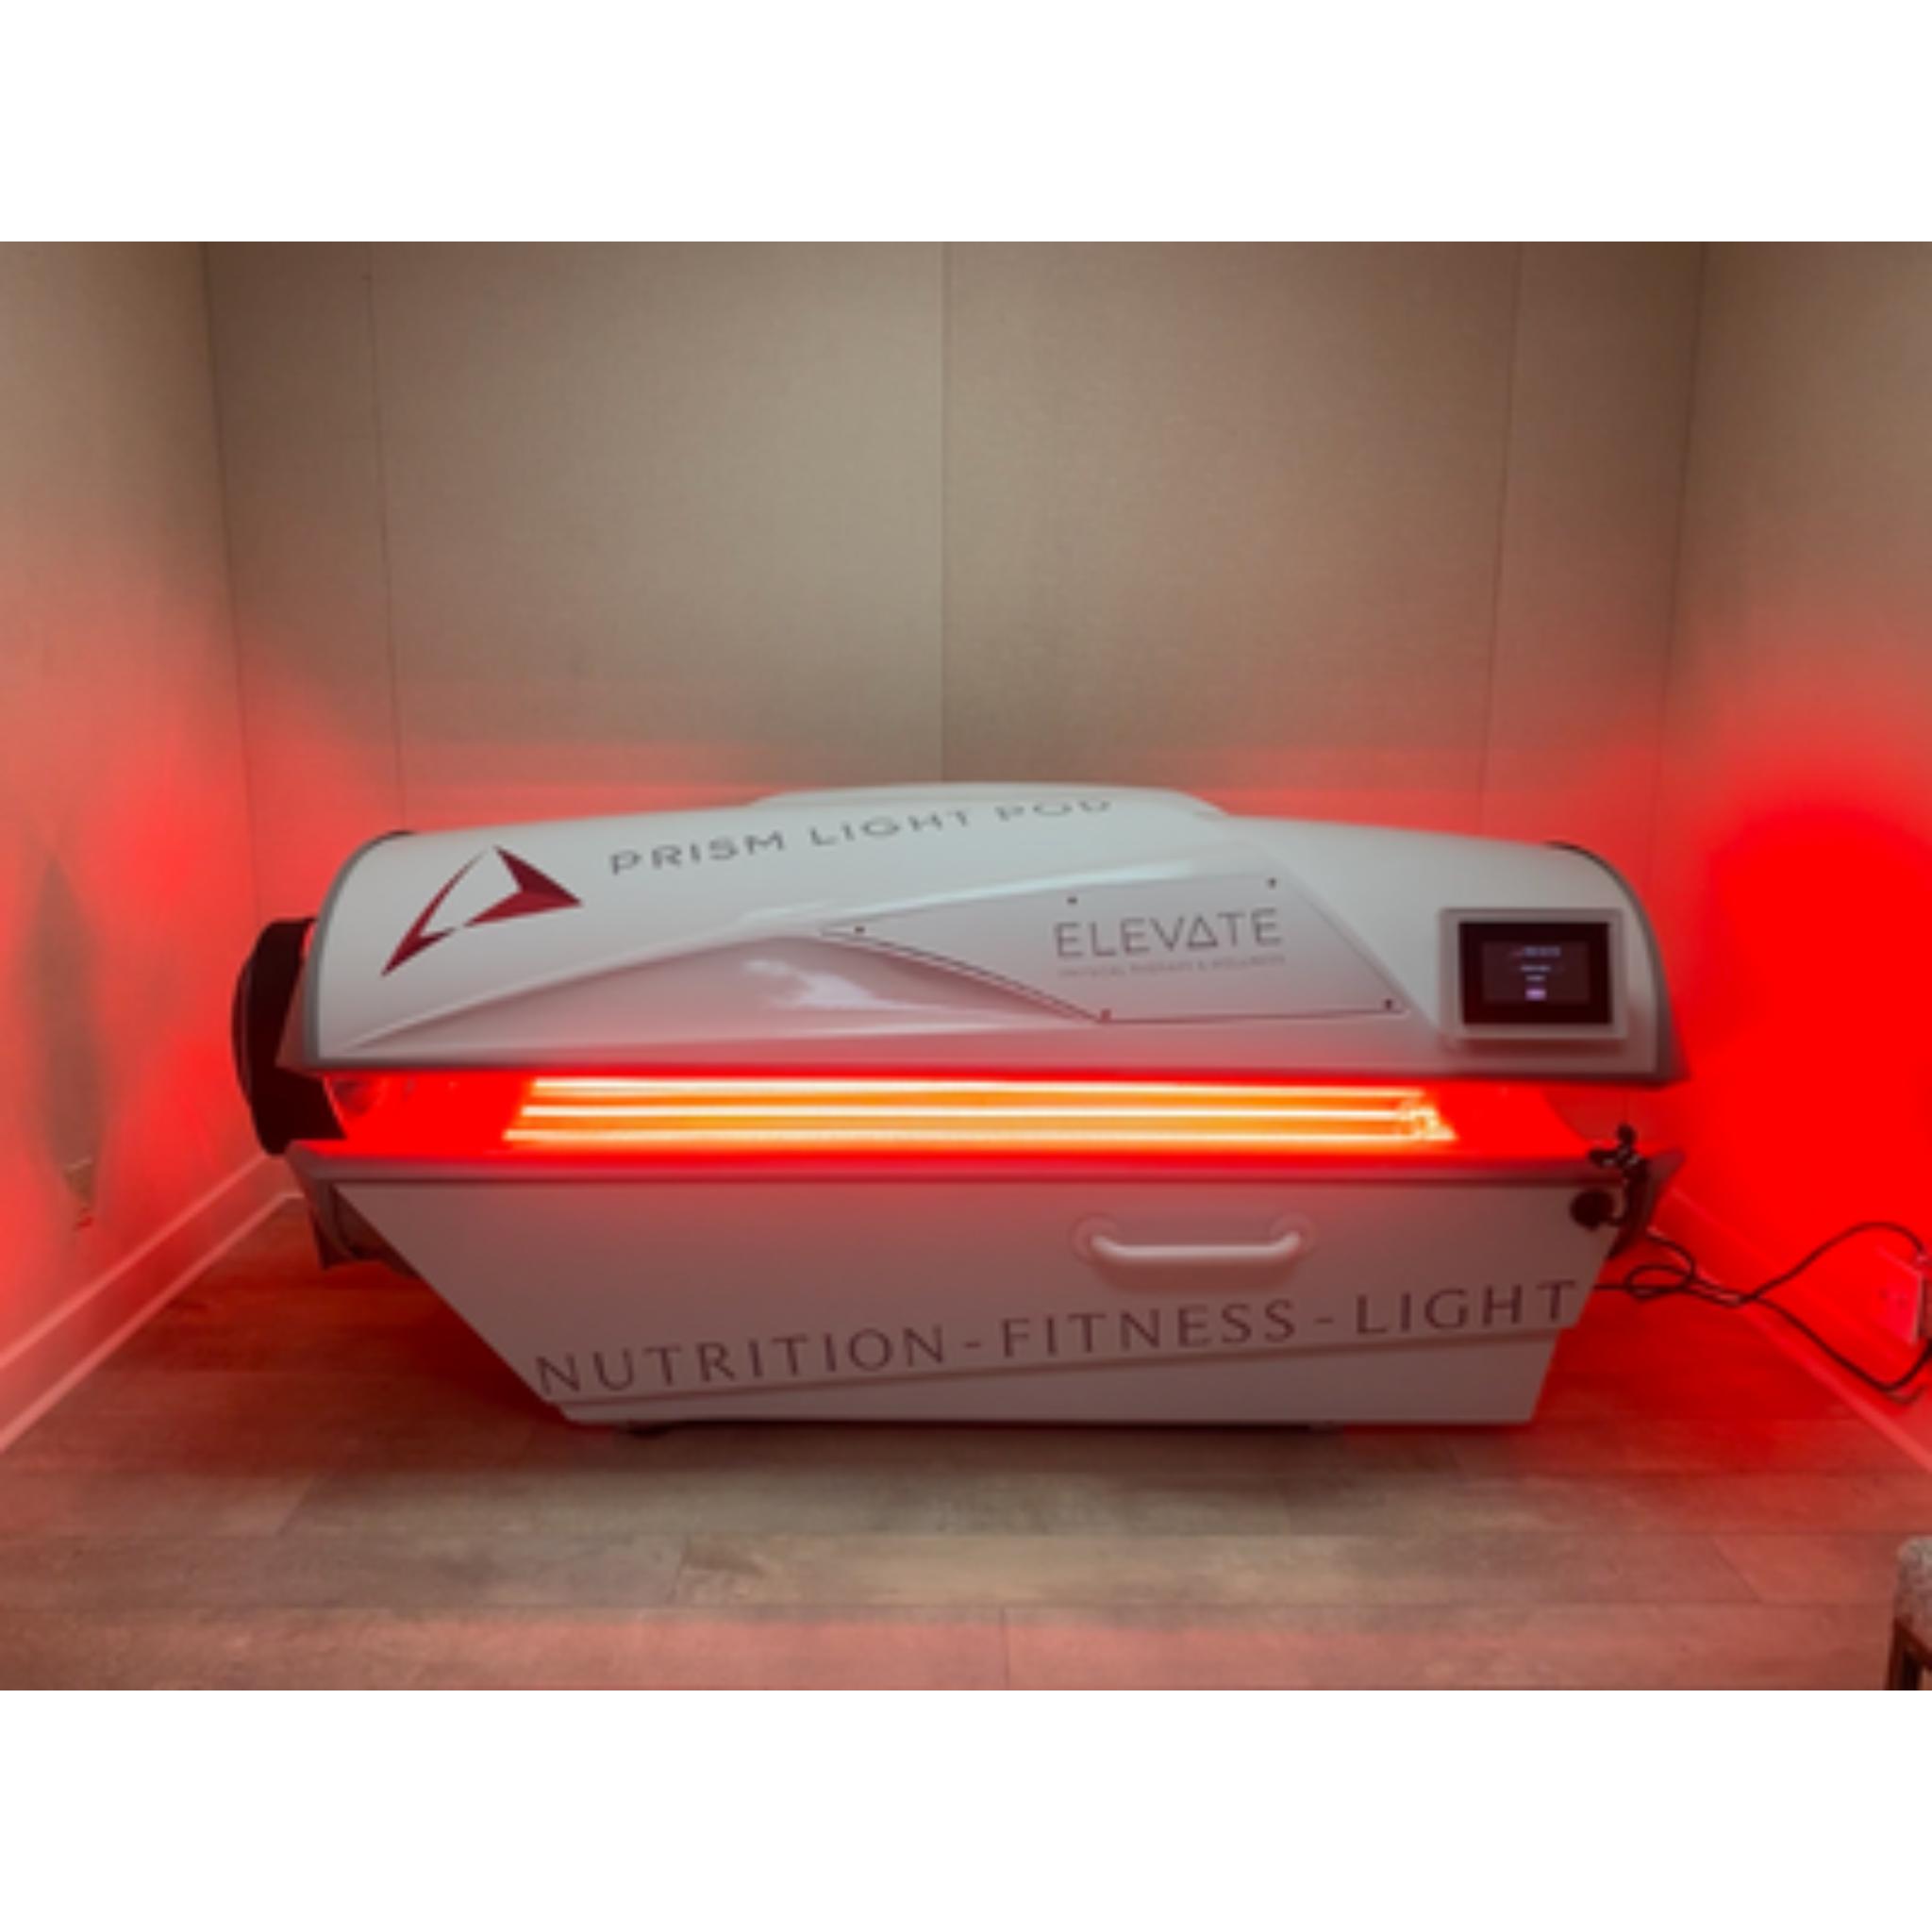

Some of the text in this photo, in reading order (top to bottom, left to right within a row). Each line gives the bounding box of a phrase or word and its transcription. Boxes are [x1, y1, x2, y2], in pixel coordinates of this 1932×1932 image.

[609, 830, 785, 875] PRISM
[808, 808, 969, 847] LIGHT
[1054, 908, 1283, 958] ELEVATE
[535, 1324, 944, 1394] NUTRITION
[1001, 1299, 1296, 1357] FITNESS
[1356, 1279, 1578, 1336] LIGHT
